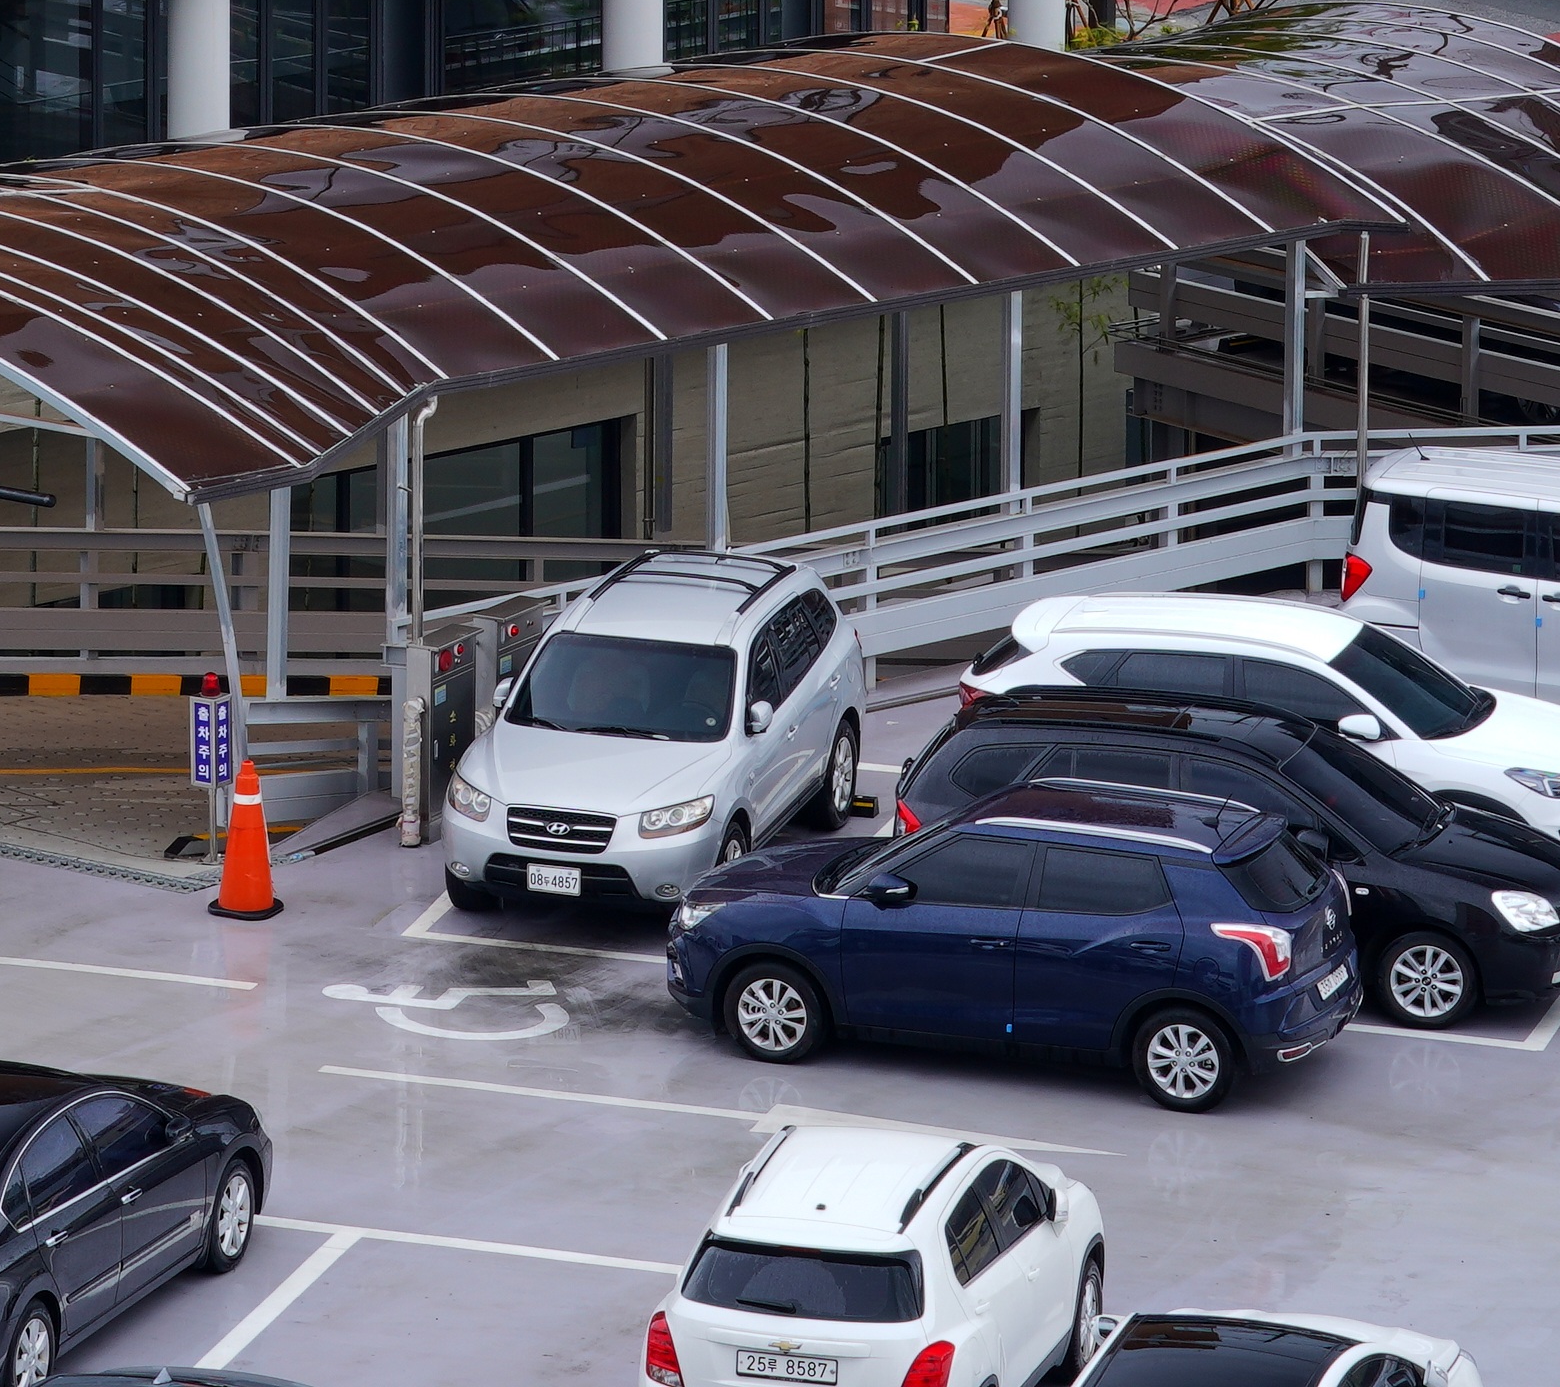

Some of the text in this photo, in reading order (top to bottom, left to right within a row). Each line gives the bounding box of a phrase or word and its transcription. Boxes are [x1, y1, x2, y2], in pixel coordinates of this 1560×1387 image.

[198, 706, 210, 779] 출차주의
[217, 705, 228, 778] 출차주의
[746, 1355, 828, 1378] 25루 8587
